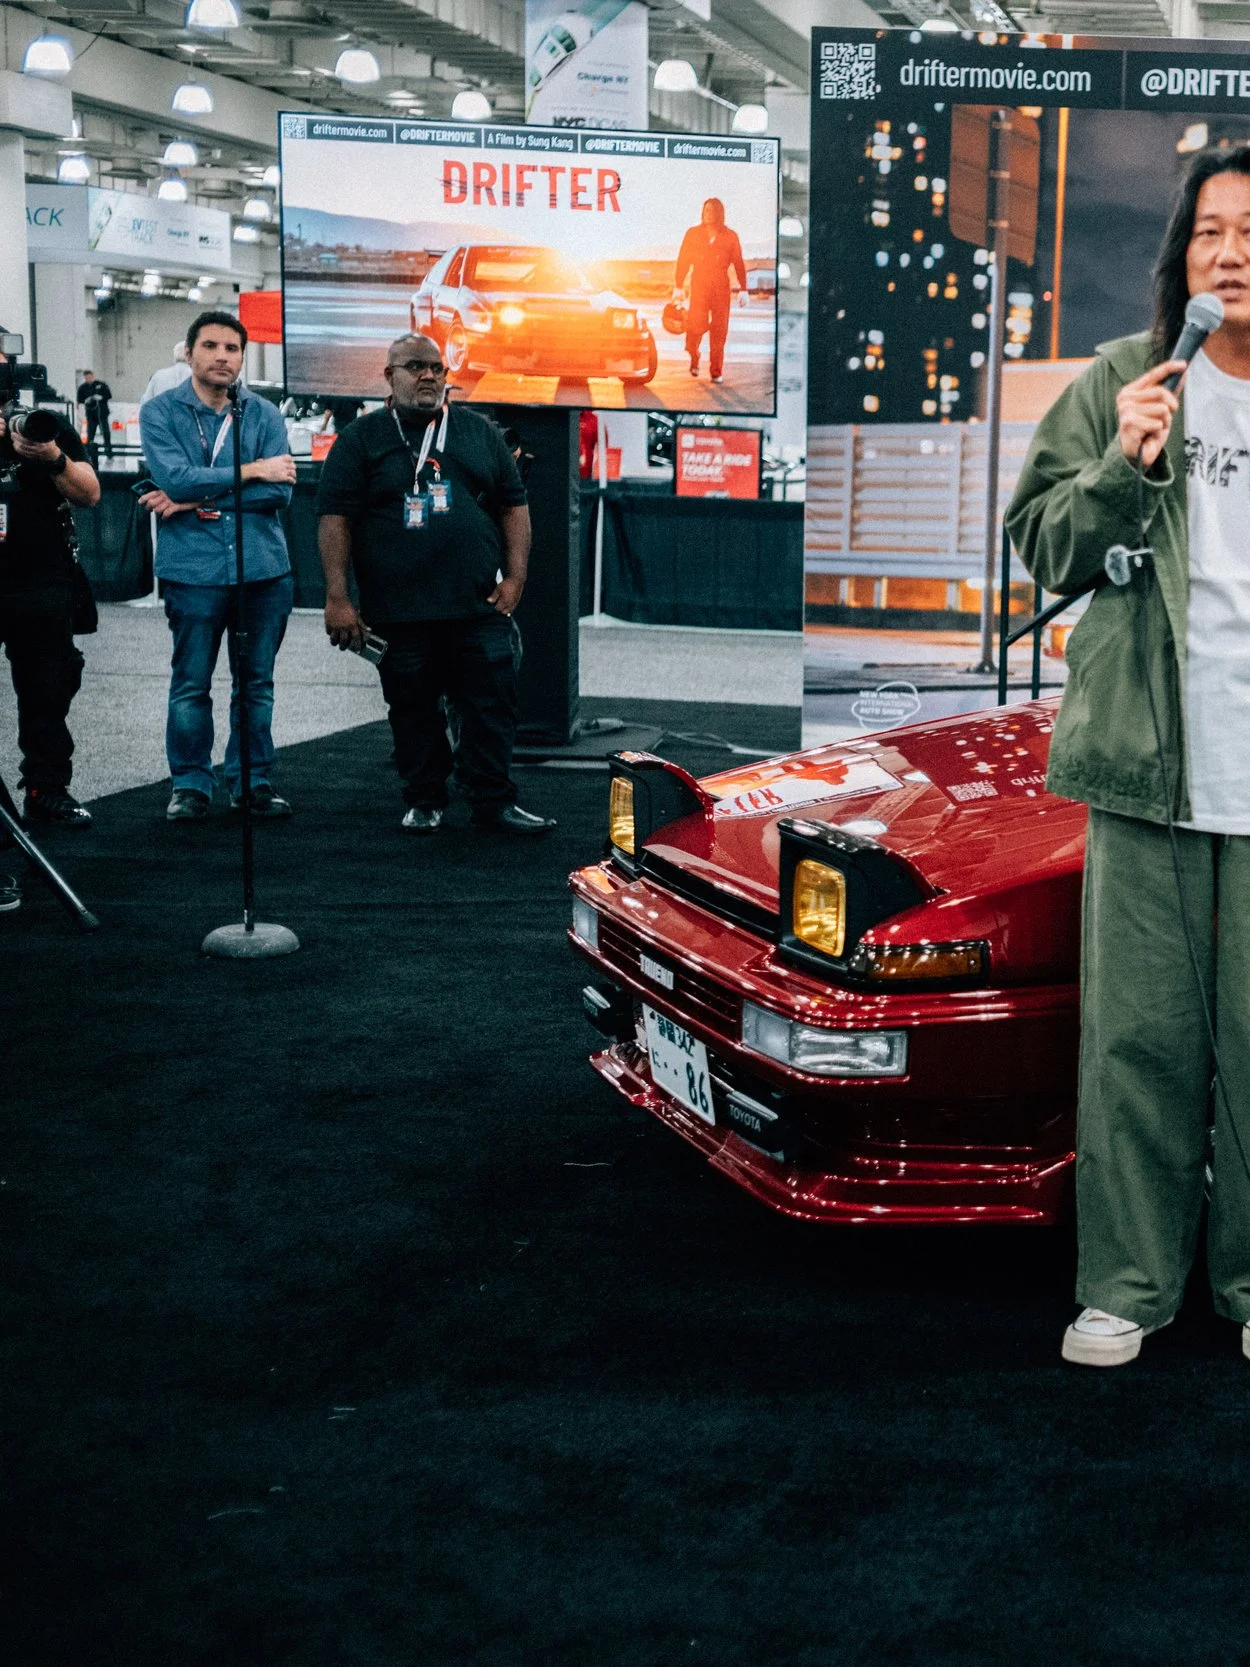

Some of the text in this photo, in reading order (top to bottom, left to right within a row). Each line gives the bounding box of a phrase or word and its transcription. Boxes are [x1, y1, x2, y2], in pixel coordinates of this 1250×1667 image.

[899, 57, 1092, 92] driftermovie.com
[312, 122, 388, 140] driftermovie.com
[400, 128, 476, 144] @DRIFTERMOVIE
[487, 133, 574, 151] A Film by Sung Kang
[585, 139, 661, 153] @DRIFTERMOVIE
[673, 142, 747, 158] driftermovie.com
[442, 159, 622, 213] DRIFTER
[686, 1061, 709, 1115] 86
[728, 1103, 762, 1133] TOYOTA
